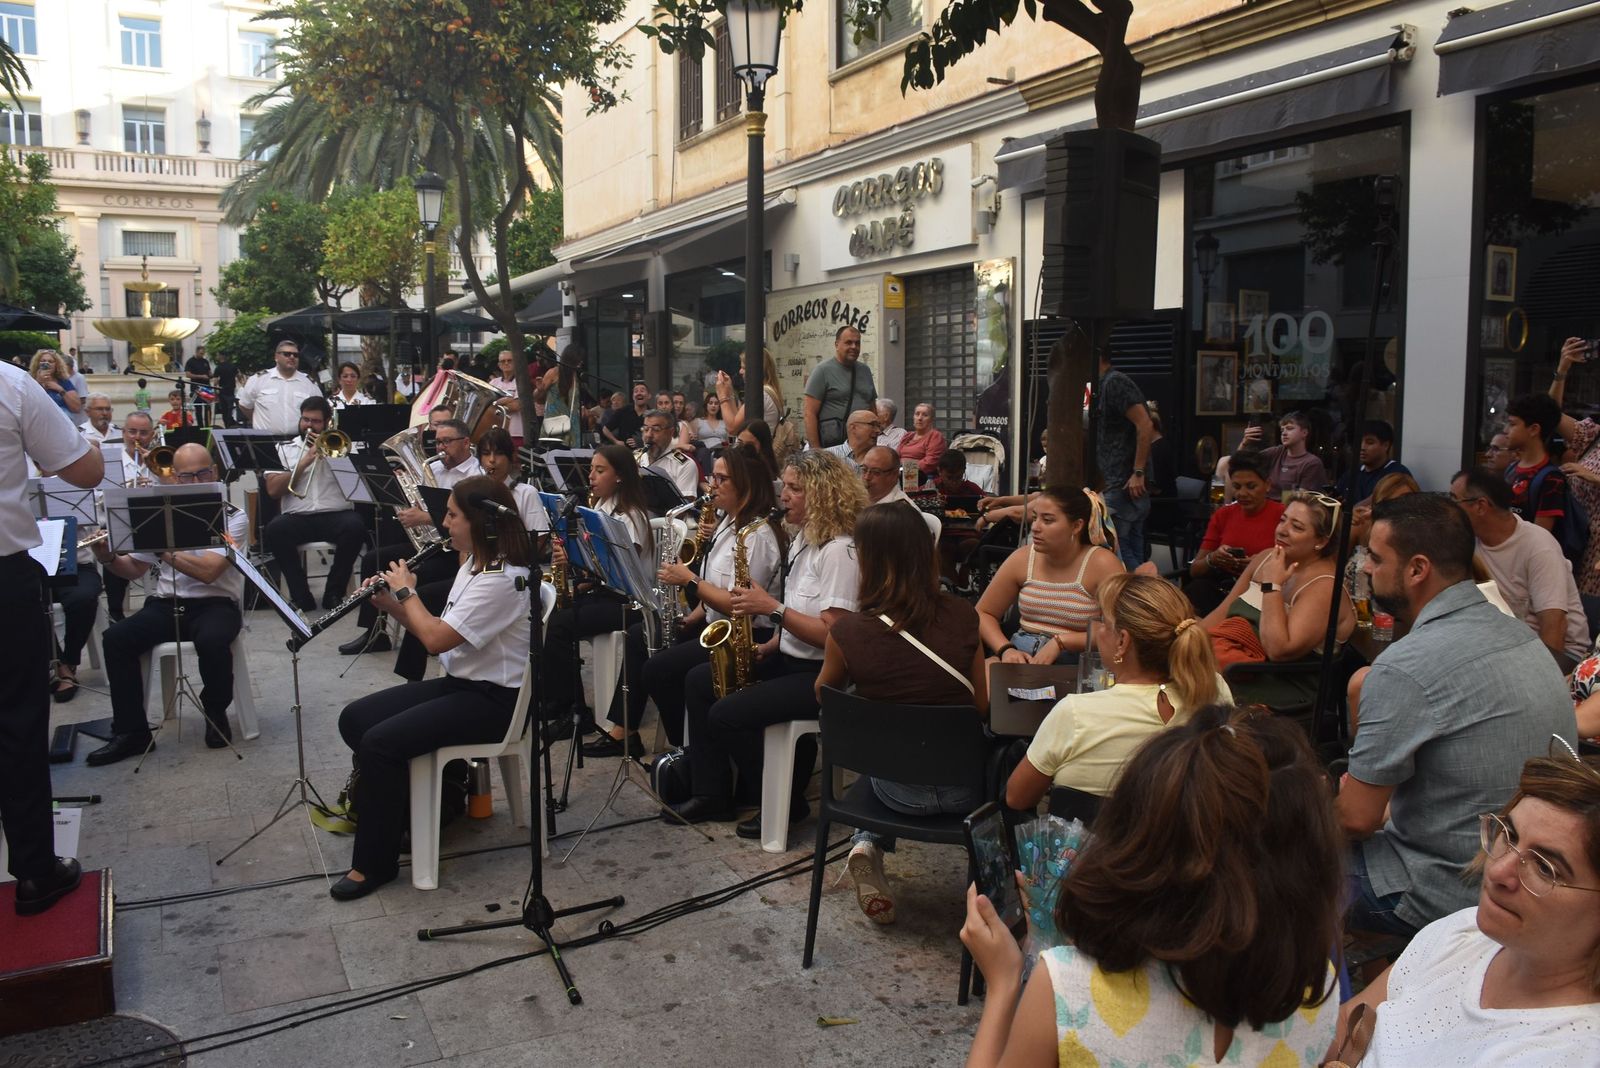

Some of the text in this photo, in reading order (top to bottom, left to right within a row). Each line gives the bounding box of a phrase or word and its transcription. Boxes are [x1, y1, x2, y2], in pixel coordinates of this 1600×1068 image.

[103, 194, 194, 209] CORREOS
[832, 157, 943, 218] CORREOS
[849, 202, 915, 258] CAFÉ
[773, 298, 871, 342] CORREOS CAFÉ
[1243, 310, 1335, 357] 100
[979, 415, 1009, 425] CORREOS
